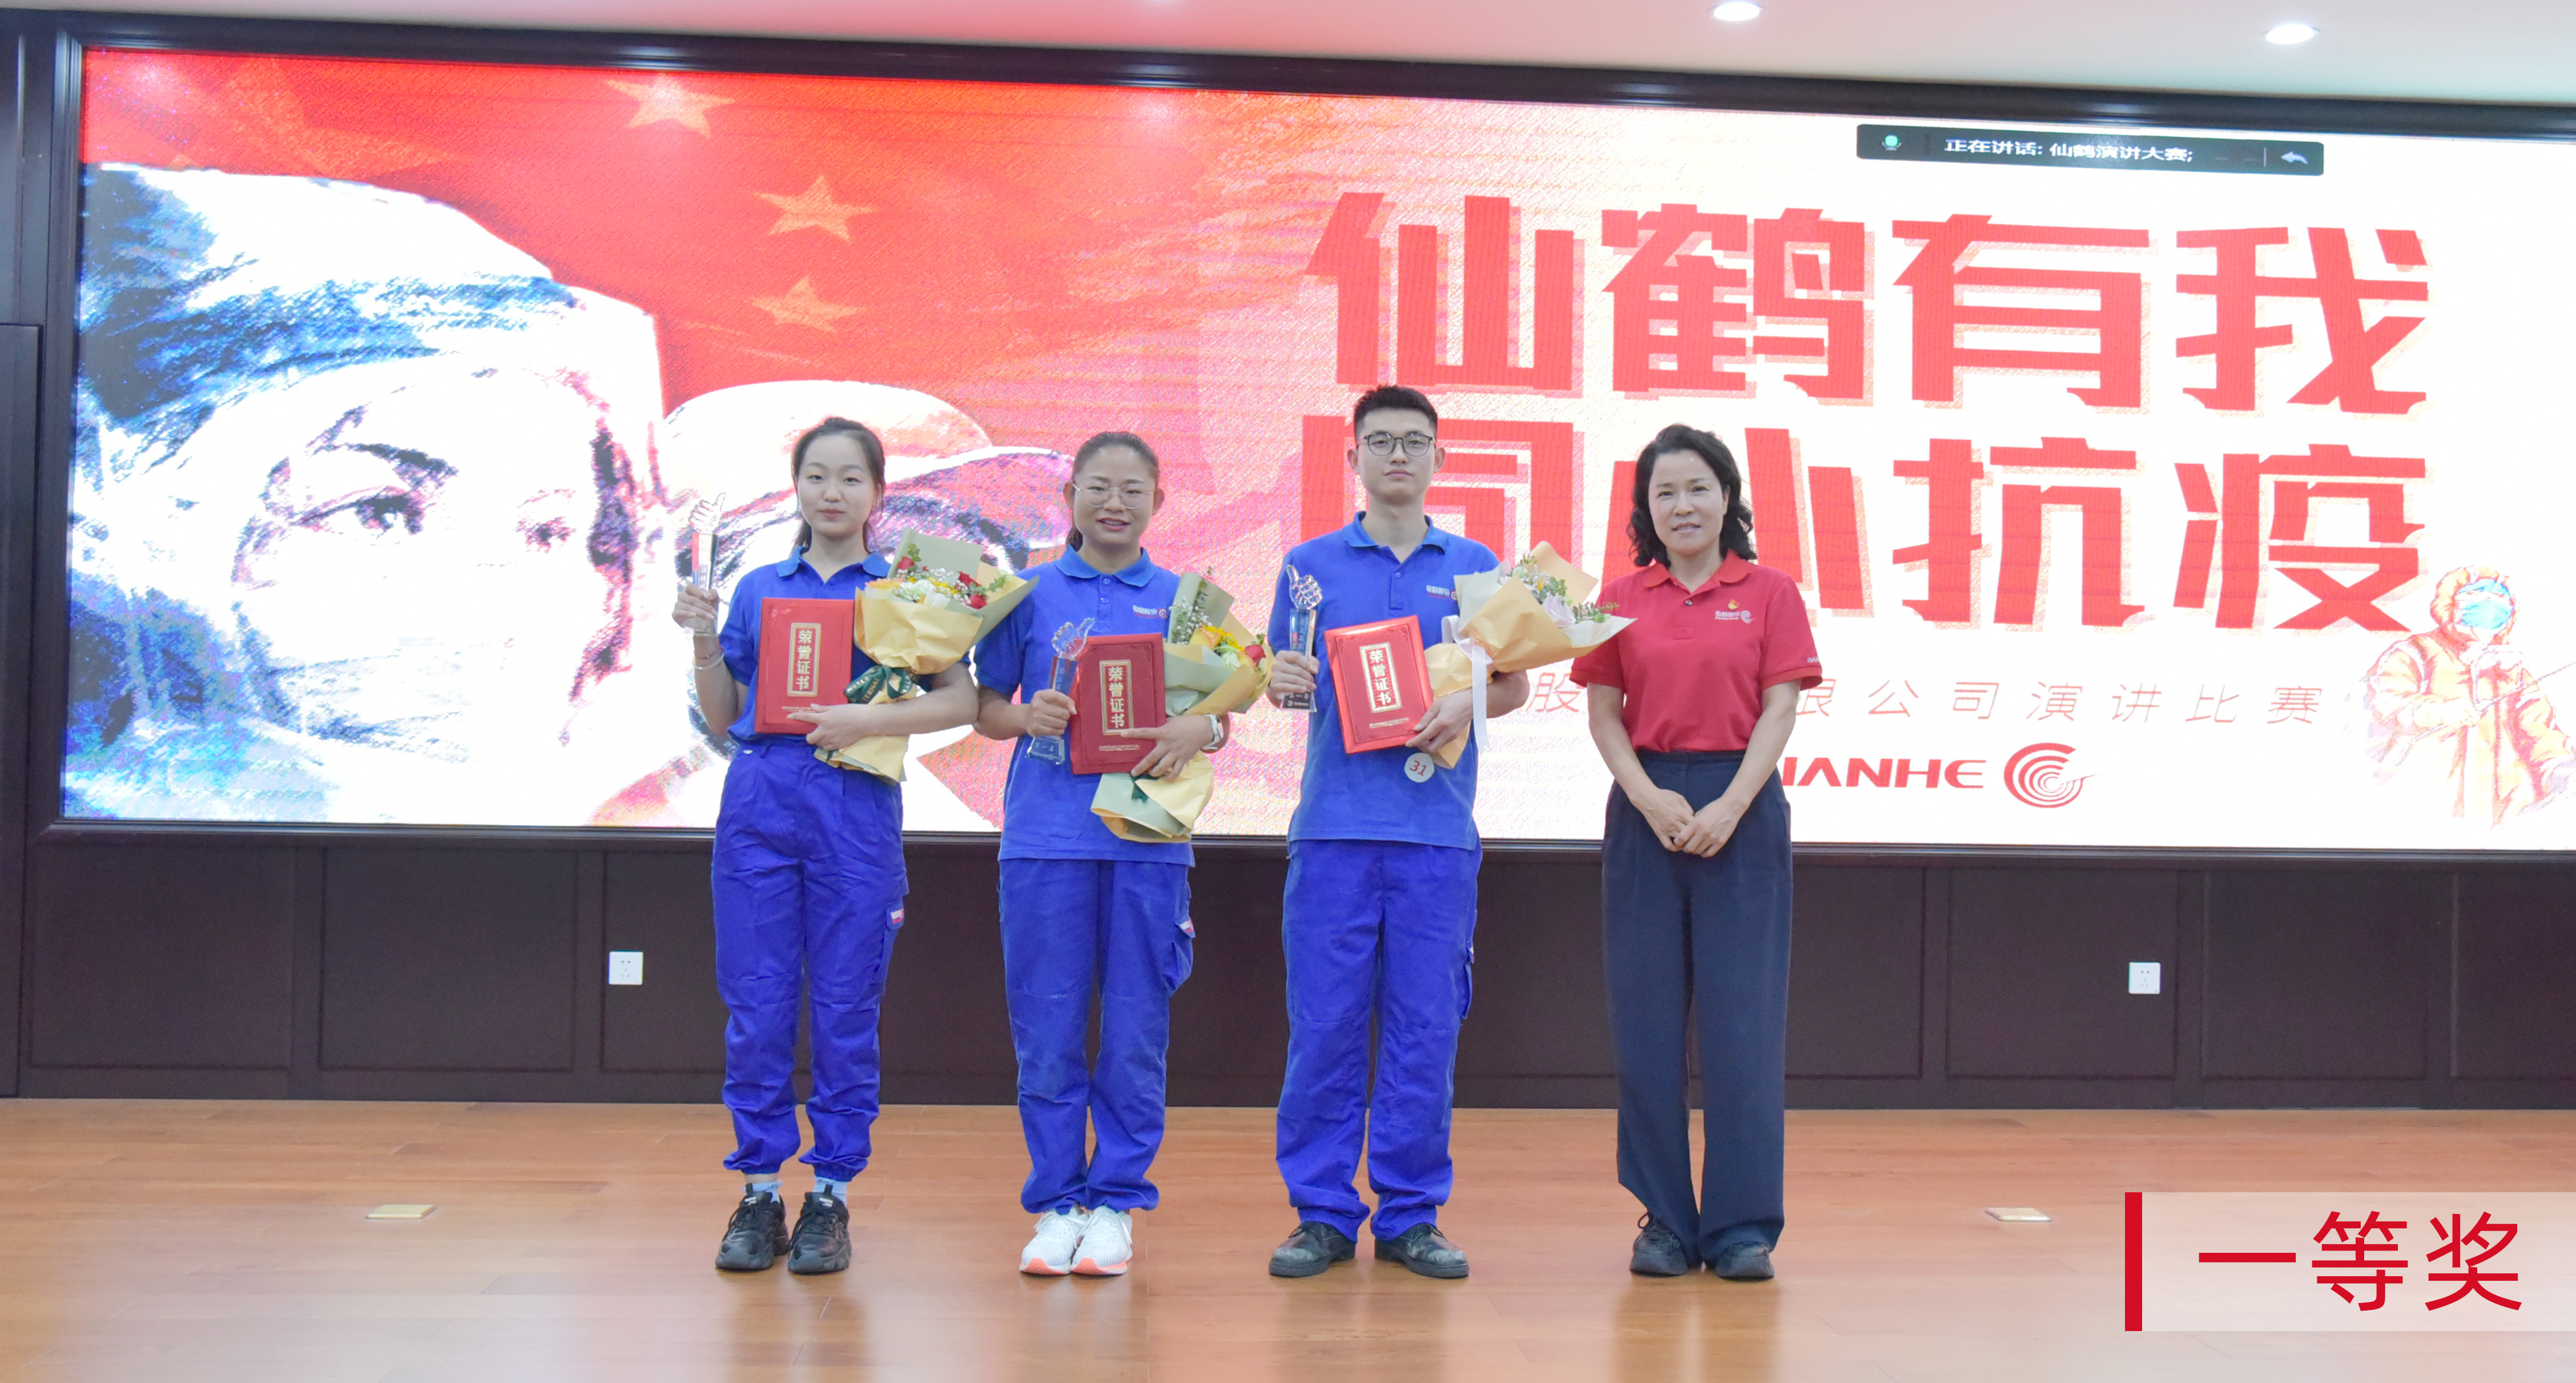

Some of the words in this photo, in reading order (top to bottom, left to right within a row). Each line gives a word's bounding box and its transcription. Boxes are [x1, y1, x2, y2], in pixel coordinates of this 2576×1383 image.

[1305, 192, 2428, 413] 仙鹤有我
[796, 629, 813, 690] 荣誉证书
[1369, 649, 1392, 705] 荣誉证书
[1108, 666, 1125, 729] 荣誉证书
[1410, 760, 1427, 777] 31
[1781, 757, 1986, 789] IANHE
